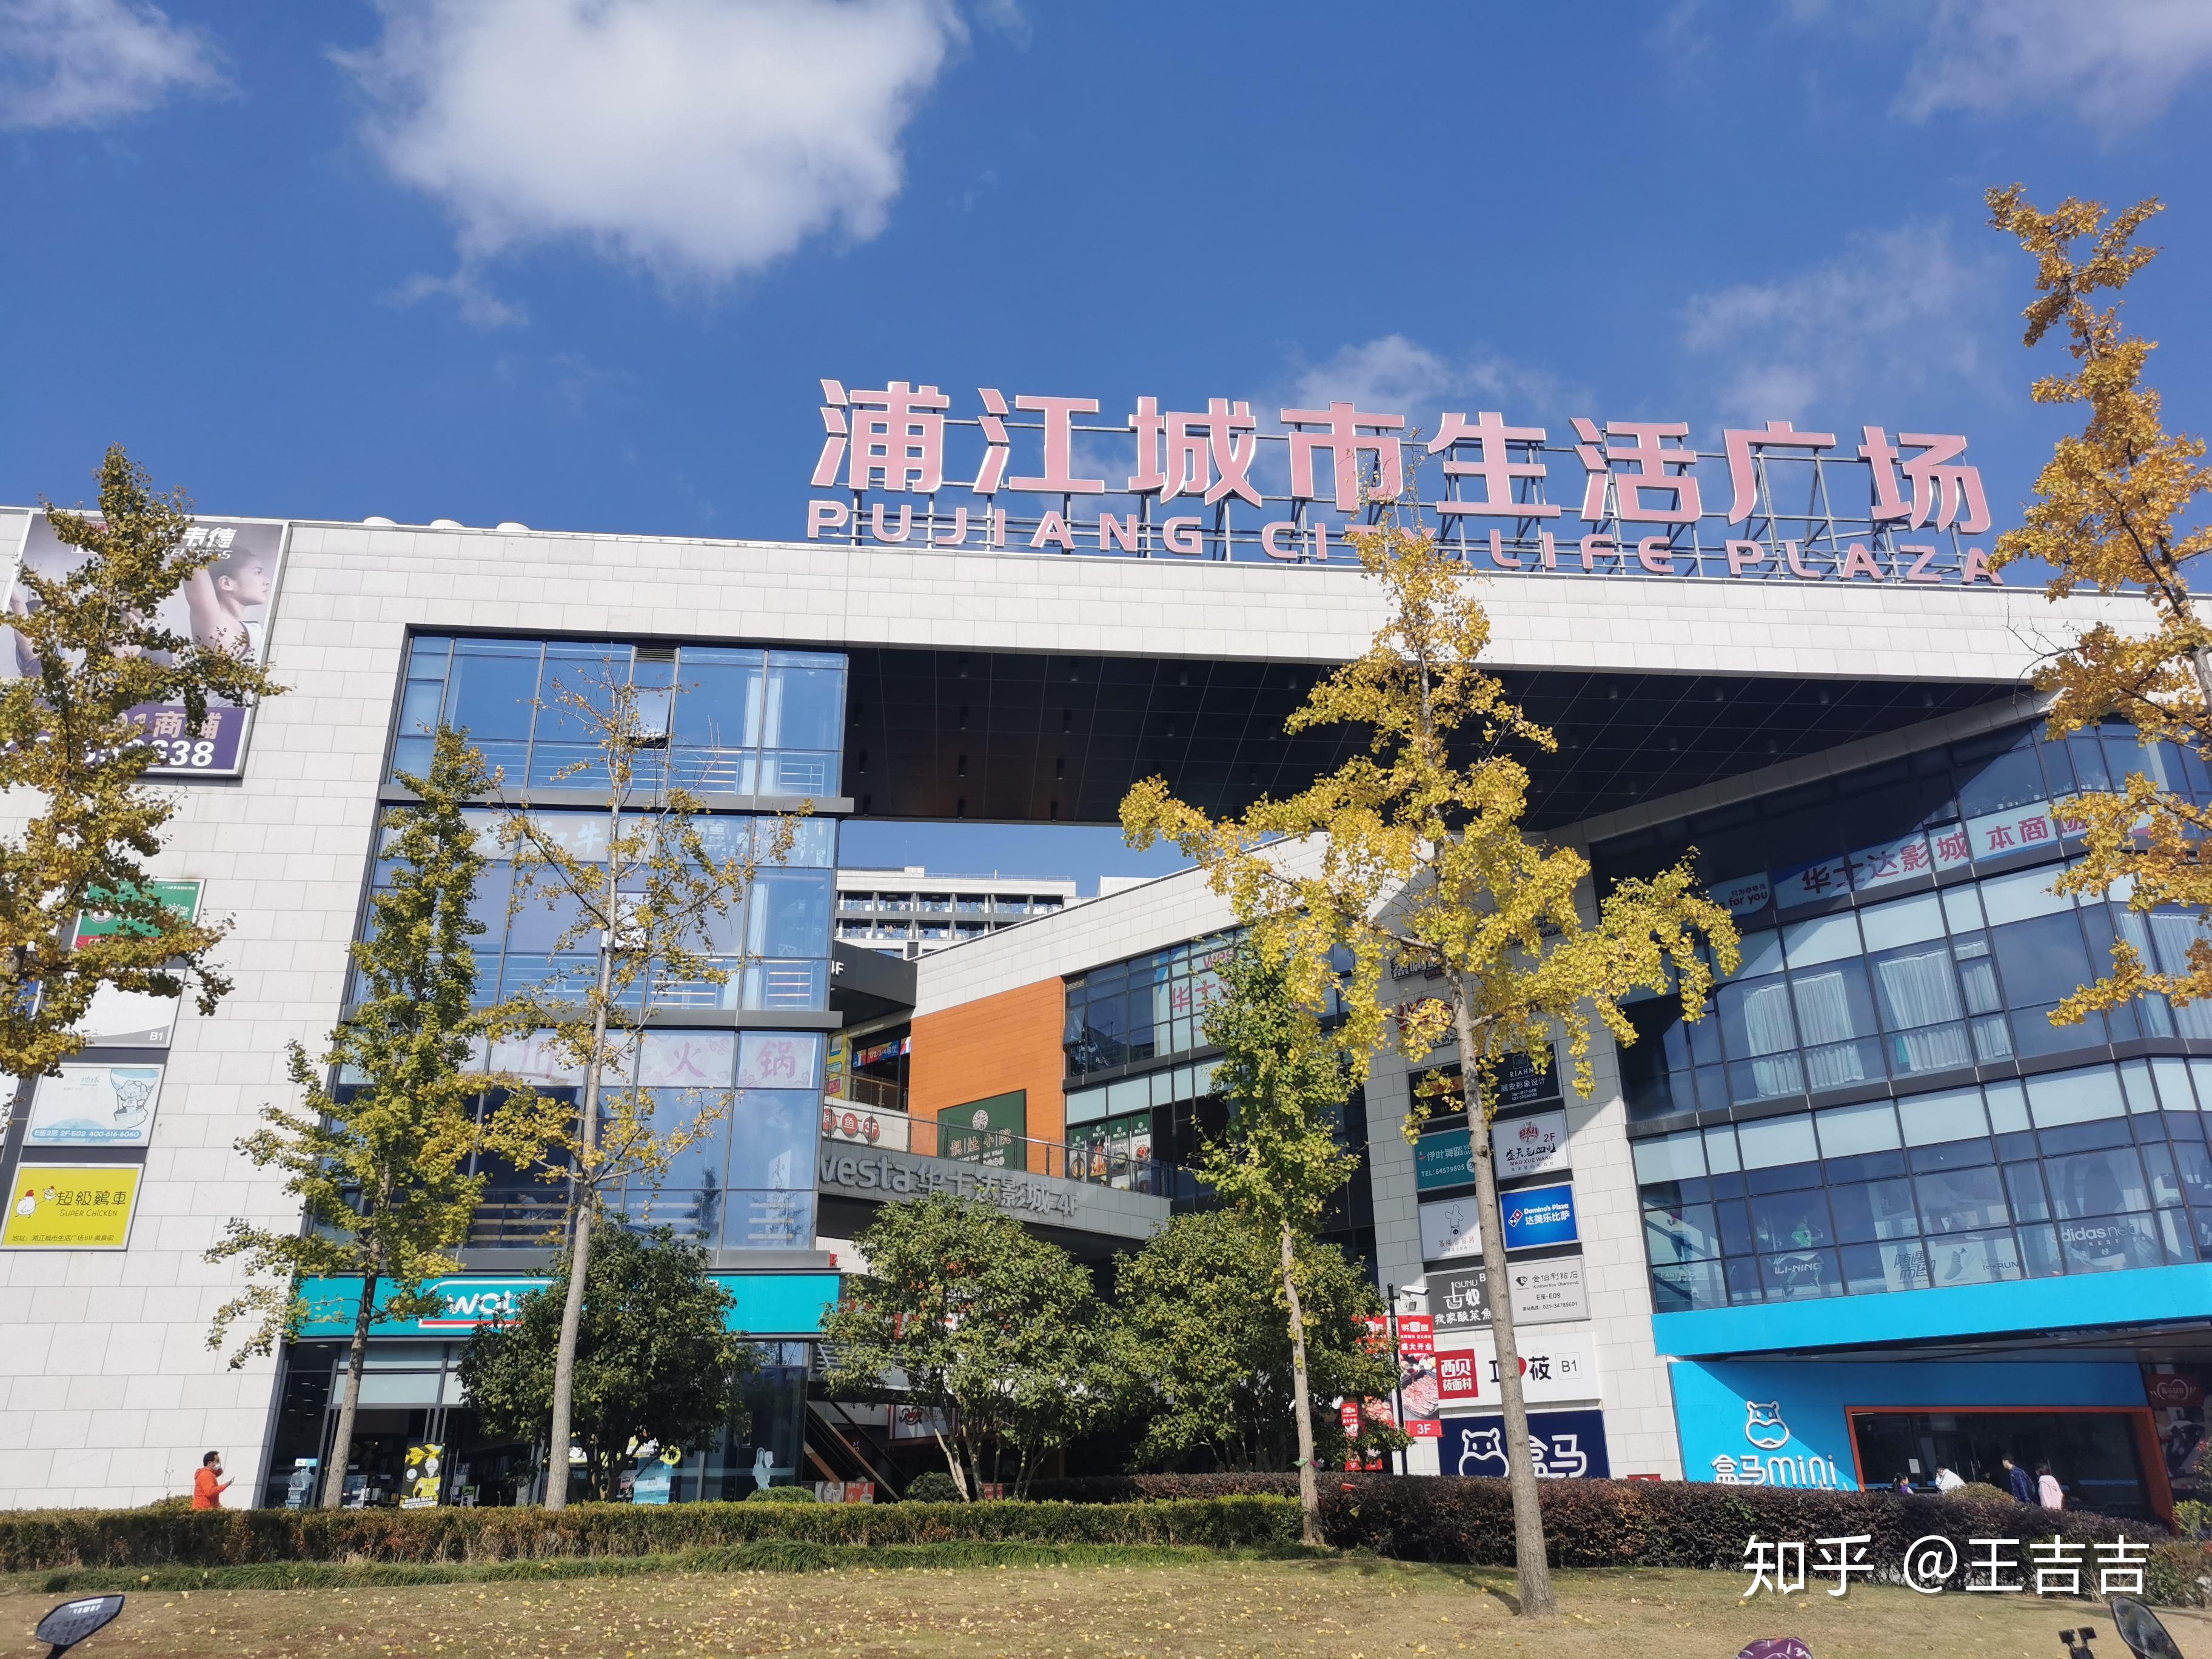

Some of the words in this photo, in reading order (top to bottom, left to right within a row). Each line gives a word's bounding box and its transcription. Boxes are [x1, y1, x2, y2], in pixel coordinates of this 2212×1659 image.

[811, 379, 1991, 535] 浦江城市生活广场
[806, 499, 1203, 556] PUJIANG
[1489, 529, 1675, 575] LIFE
[1724, 538, 2004, 586] PLAZA
[1801, 833, 1971, 894] 华士达影城
[1728, 896, 1744, 907] for
[1748, 891, 1768, 905] you
[150, 1032, 164, 1041] B1
[1544, 1133, 1555, 1142] 2F
[1427, 1146, 1463, 1161] 伊叶舞蹈
[1421, 1164, 1465, 1177] TEL:64579805
[1057, 1193, 1079, 1217] 4F
[1523, 1205, 1551, 1215] Domino's
[59, 1208, 84, 1217] SUPER
[85, 1208, 118, 1218] CHICKEN
[1525, 1210, 1570, 1225] 达美乐比萨
[1401, 1342, 1432, 1350] 盛大开业
[1528, 1355, 1552, 1381] 莜
[1561, 1359, 1577, 1373] B1
[1442, 1377, 1472, 1392] 莜面村
[1416, 1424, 1432, 1435] 3F
